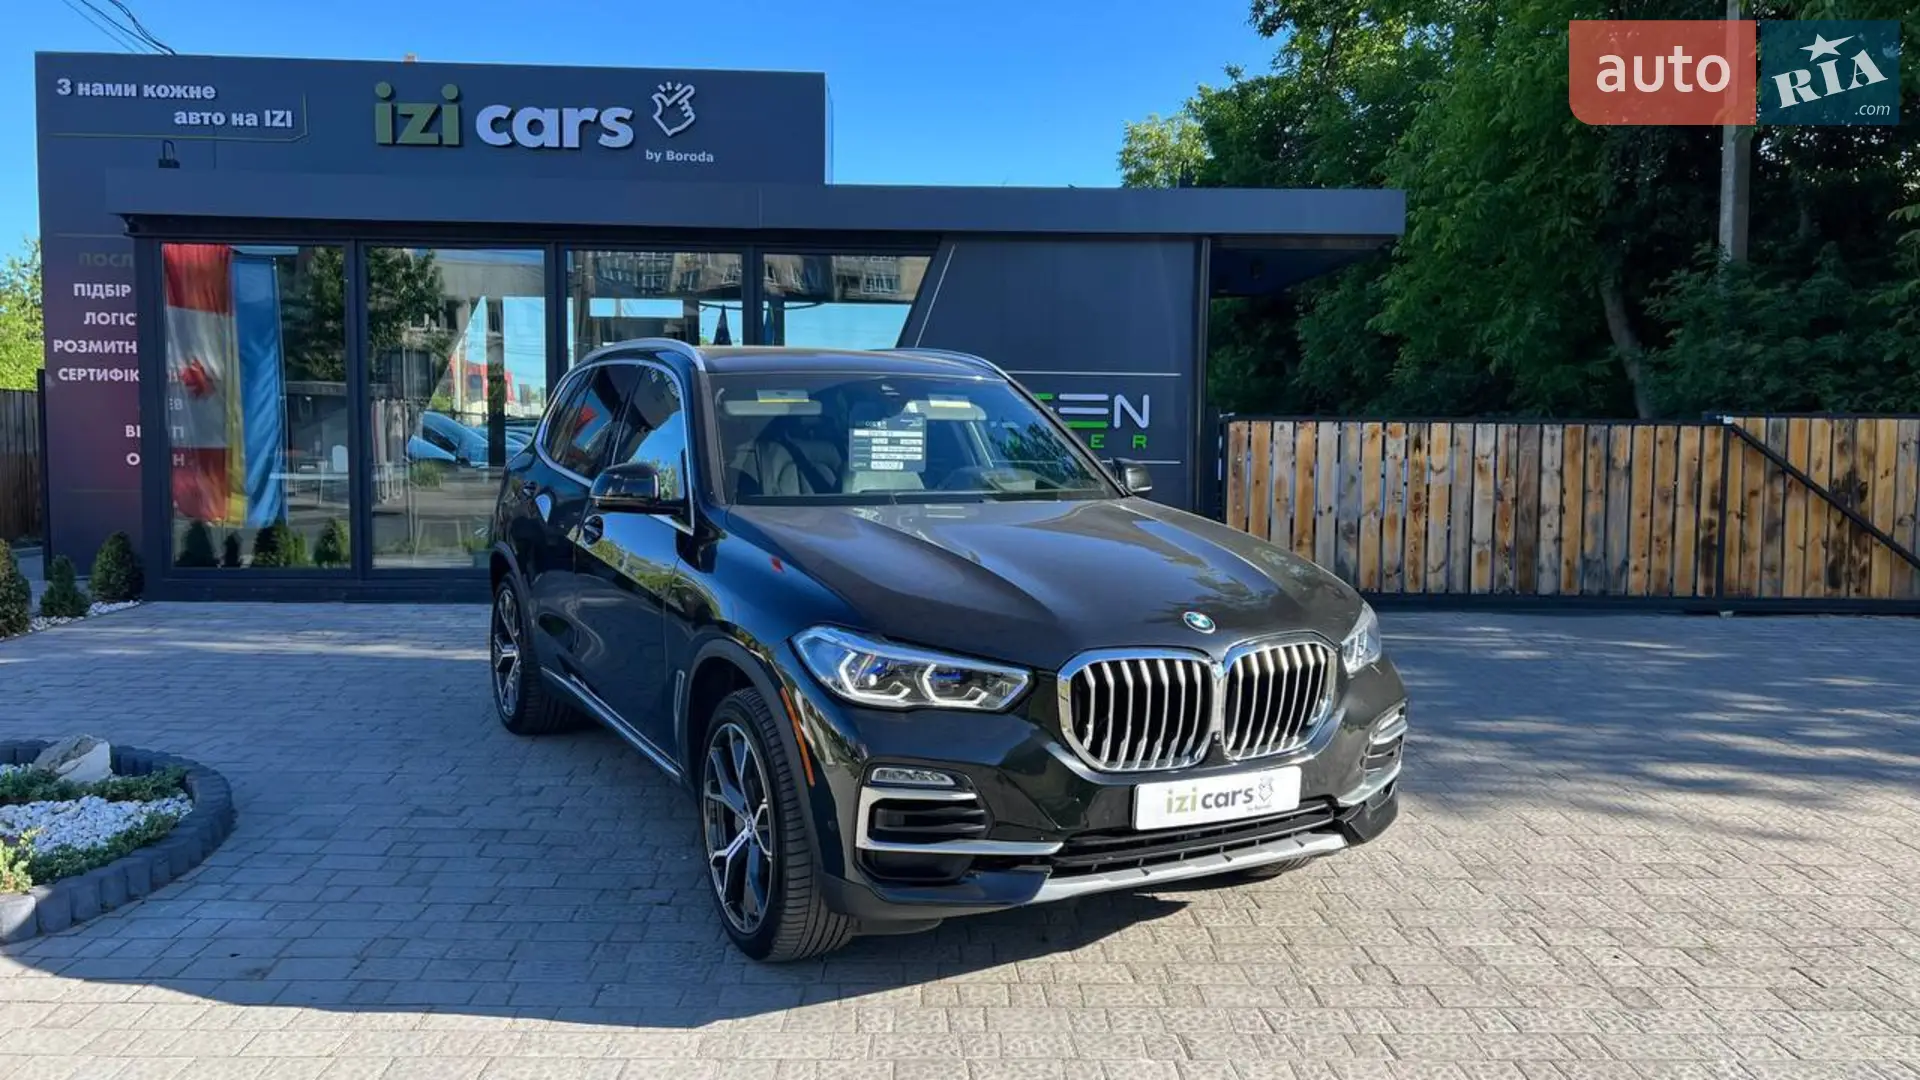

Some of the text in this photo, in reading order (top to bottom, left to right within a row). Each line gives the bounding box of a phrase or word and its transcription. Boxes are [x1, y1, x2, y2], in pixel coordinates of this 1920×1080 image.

[77, 81, 137, 98] нами
[143, 83, 216, 100] кожне
[174, 109, 293, 128] авто на IZI
[375, 81, 635, 148] izi cars
[645, 150, 714, 163] by Boroda
[79, 252, 134, 268] ПОСЛ
[73, 283, 131, 299] ПІДБІР
[84, 312, 137, 326] ЛОГІС
[53, 340, 137, 354] РОЗМИТН
[58, 367, 140, 382] СЕРТИФІК
[1166, 787, 1198, 814] izi
[1201, 787, 1254, 809] cars
